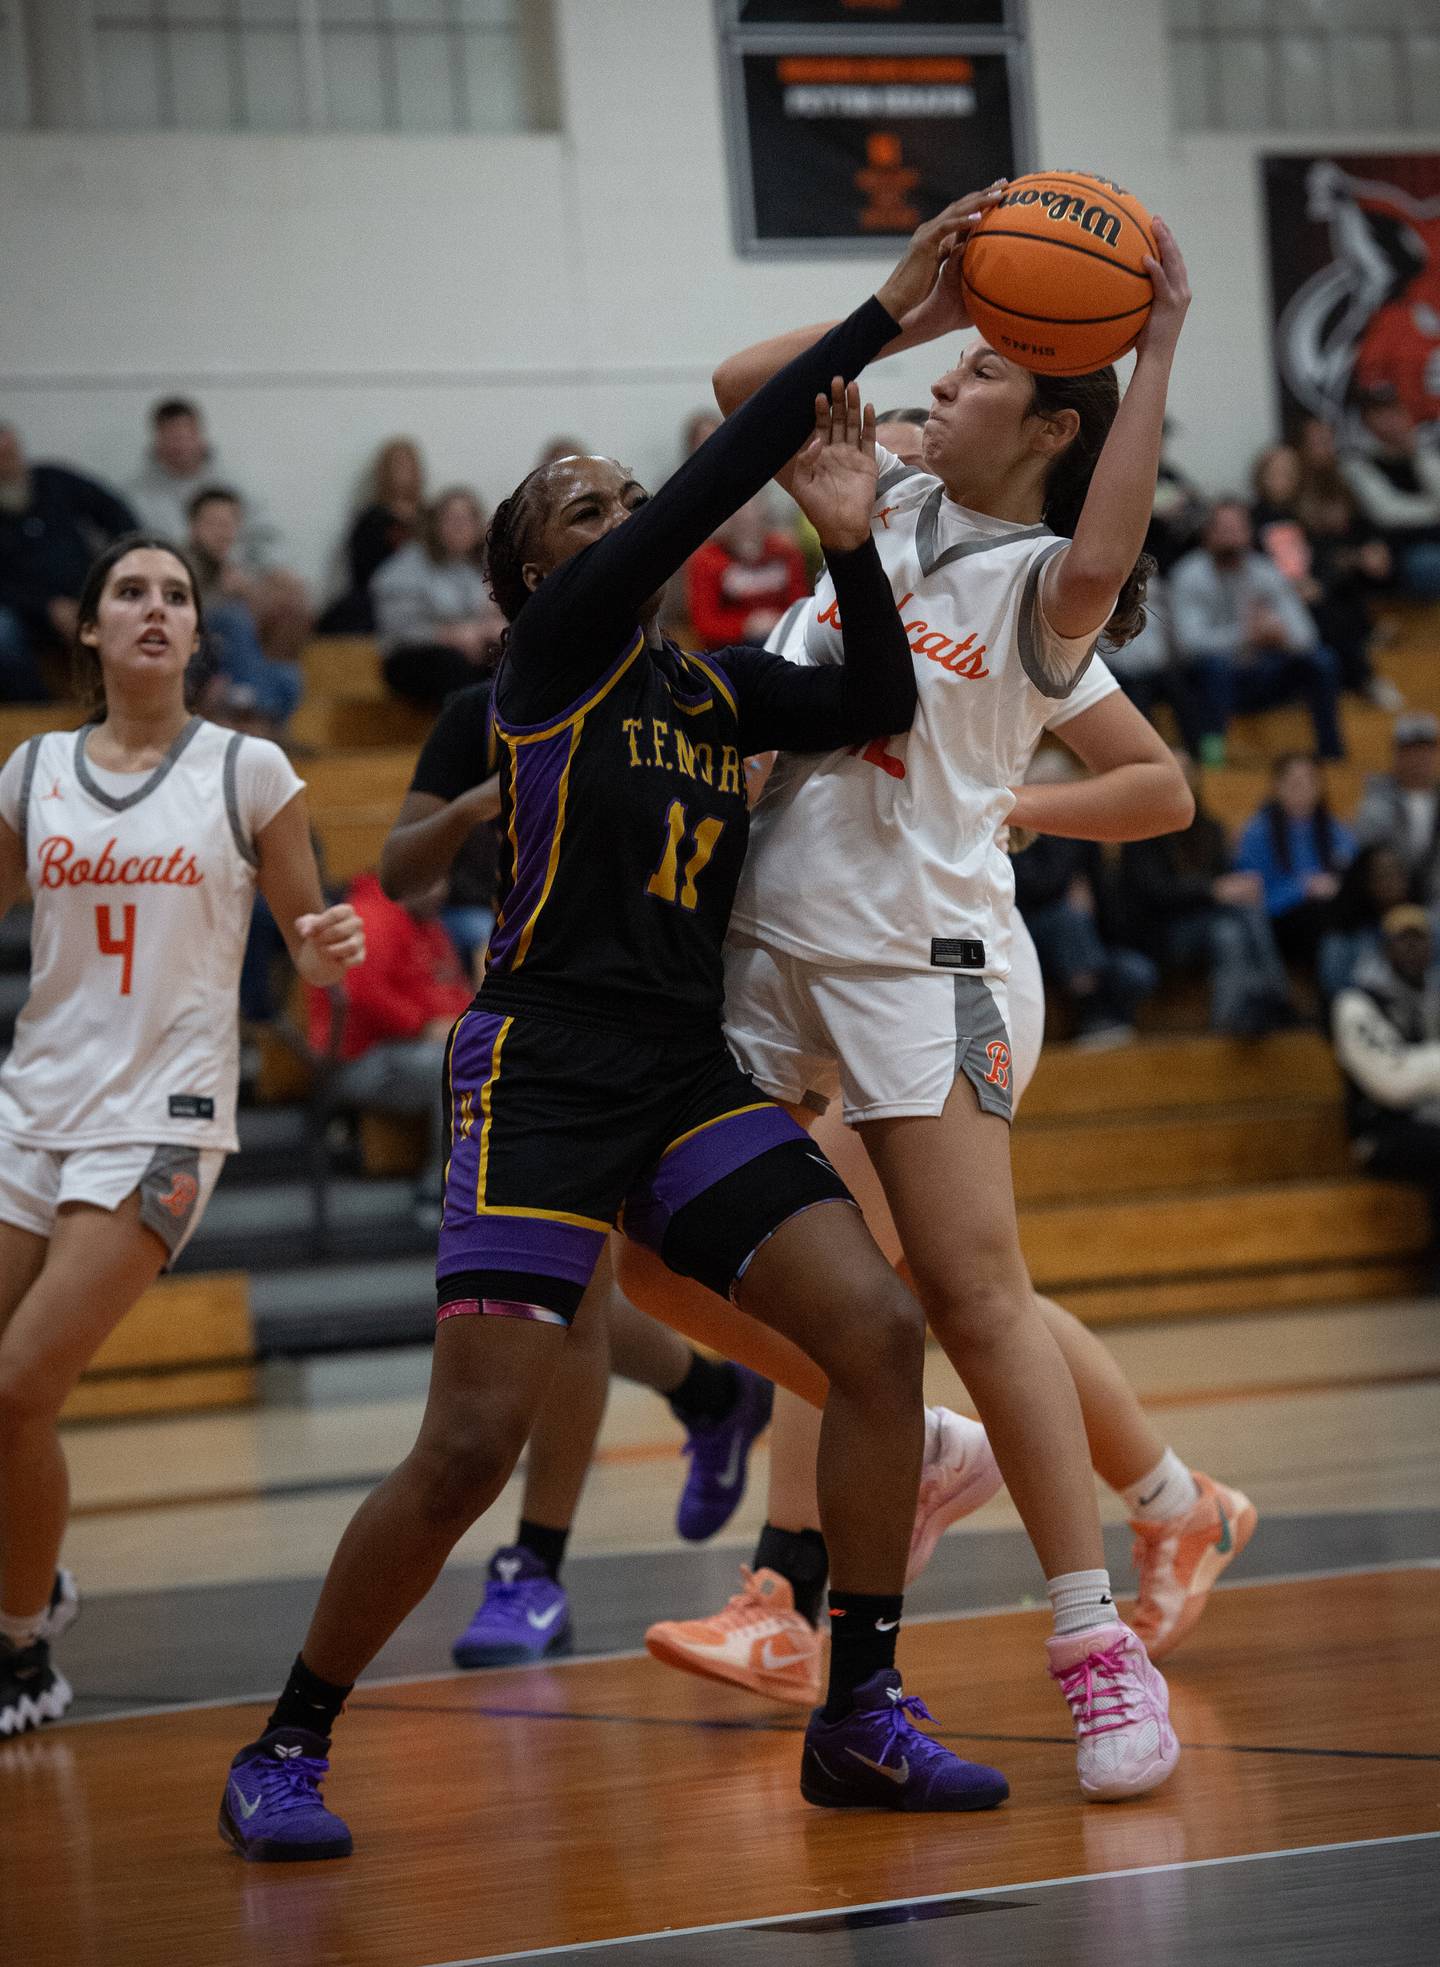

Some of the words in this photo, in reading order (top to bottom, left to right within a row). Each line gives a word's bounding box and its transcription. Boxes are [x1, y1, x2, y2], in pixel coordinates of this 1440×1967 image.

[998, 189, 1123, 249] Wilson
[38, 833, 204, 890] Bobcats
[644, 798, 727, 911] 11
[95, 903, 136, 997] 4
